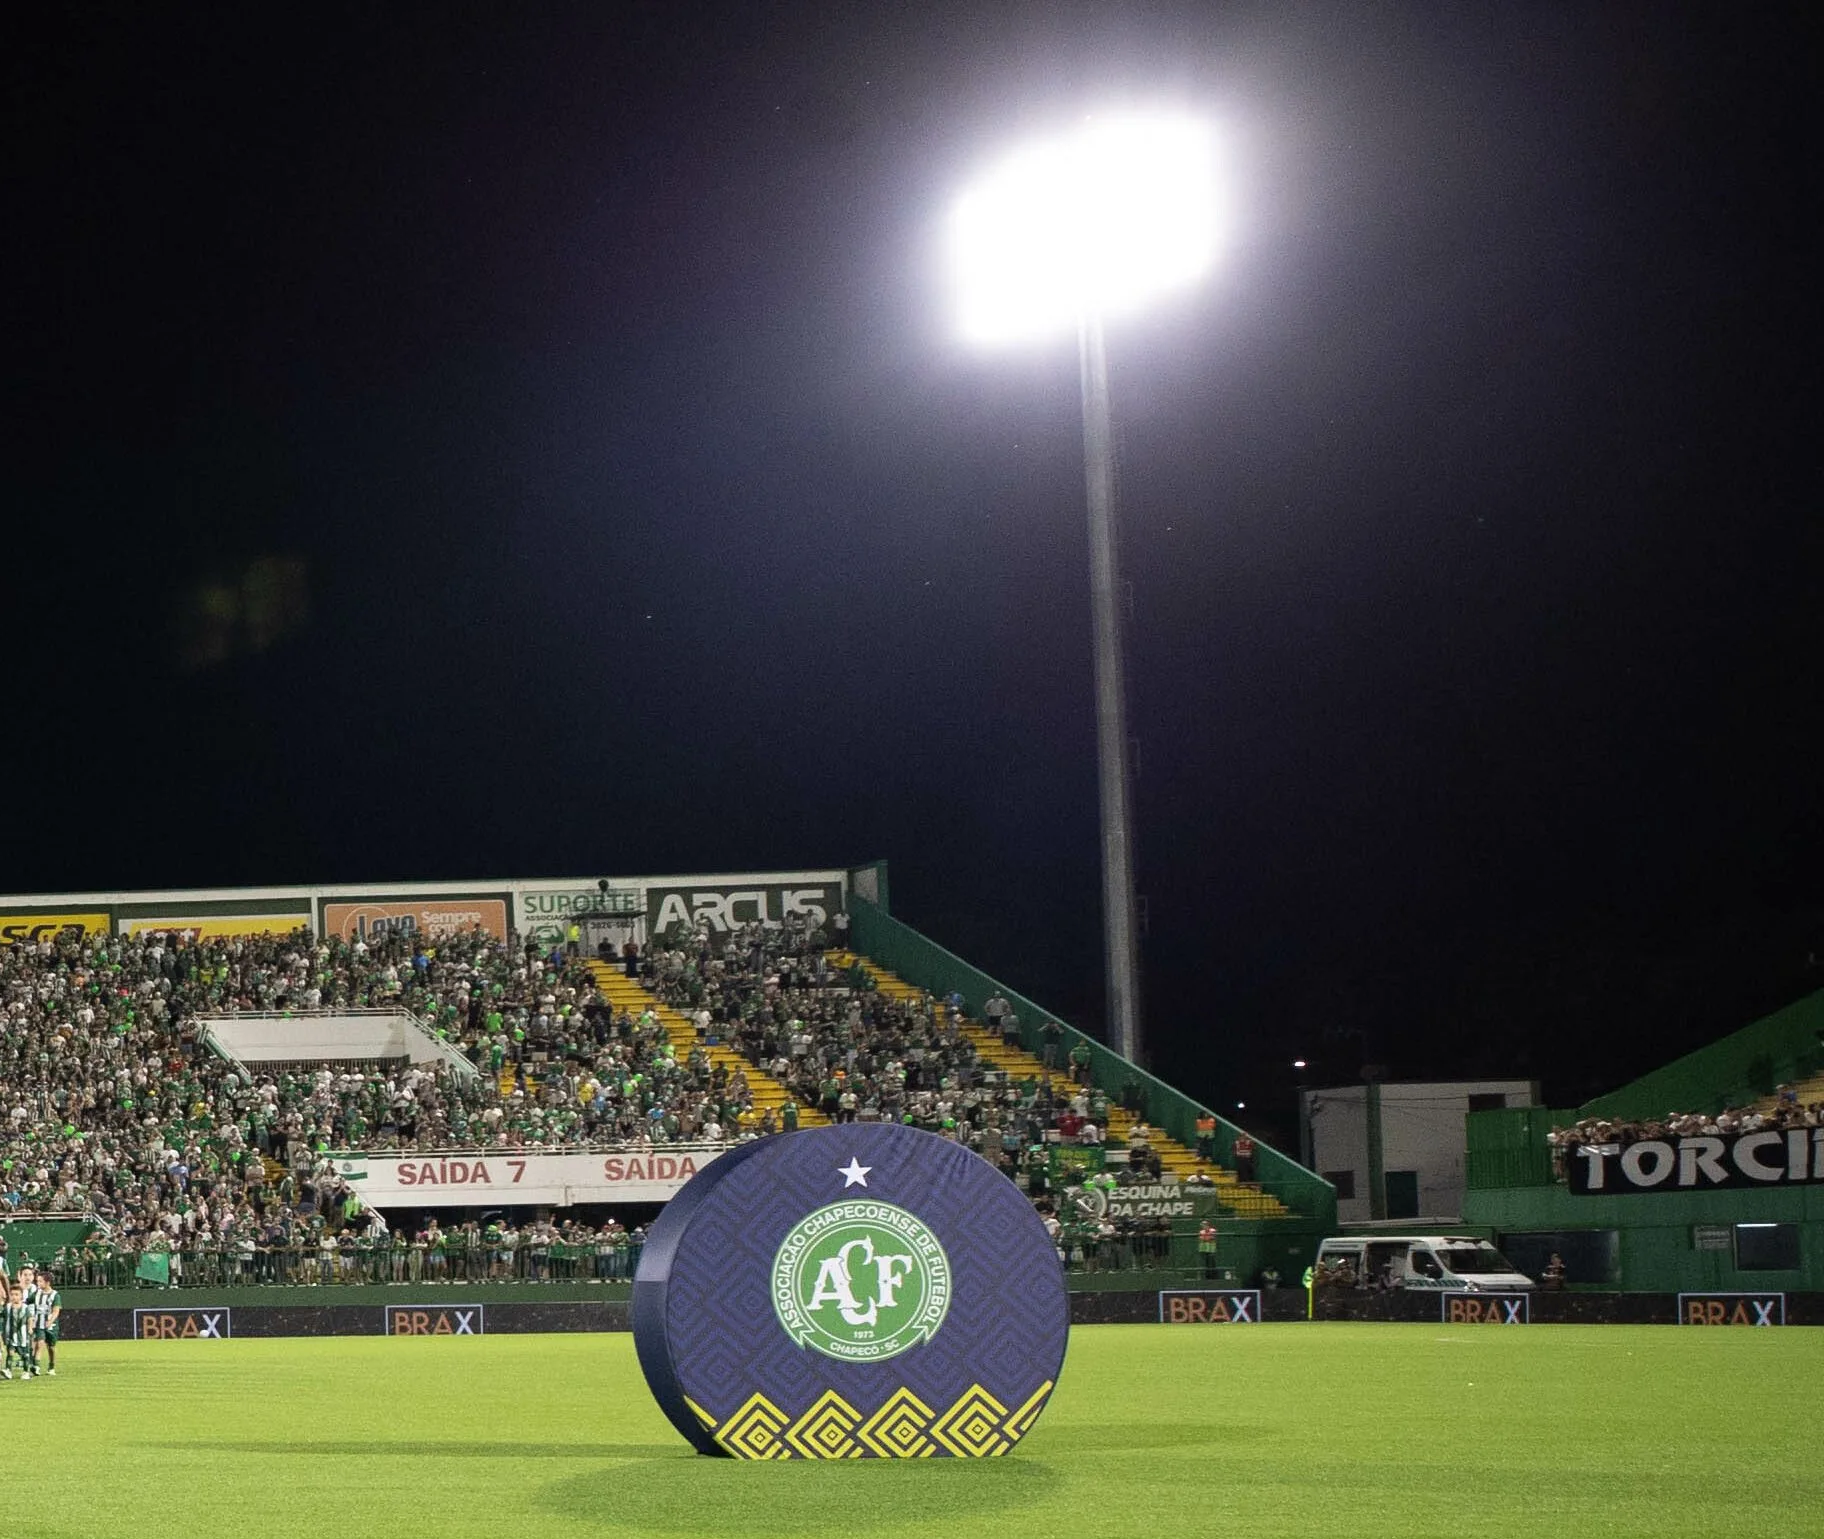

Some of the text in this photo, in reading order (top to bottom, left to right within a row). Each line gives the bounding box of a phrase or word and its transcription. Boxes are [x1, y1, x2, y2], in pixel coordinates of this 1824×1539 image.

[524, 894, 634, 914] SUPORTE
[654, 889, 827, 934] ARCUS
[421, 911, 481, 925] Sempre
[398, 1158, 527, 1185] SAÍDA 7
[604, 1154, 698, 1181] SAÍDA
[1576, 1129, 1824, 1189] TORCI
[1108, 1185, 1182, 1201] ESQUINA
[1113, 1202, 1195, 1217] DA CHAPE
[777, 1204, 947, 1329] ASSOCIAÇÃO CHAPECOENSE DE FUTEBOL
[1169, 1296, 1252, 1323] BRAX
[1451, 1299, 1521, 1324] BRAX
[1688, 1301, 1775, 1326] BRAX
[142, 1314, 221, 1339] BRAX
[394, 1311, 475, 1336] BRAX
[853, 1330, 875, 1339] 1973
[829, 1338, 900, 1356] CHAPECÓ SC
